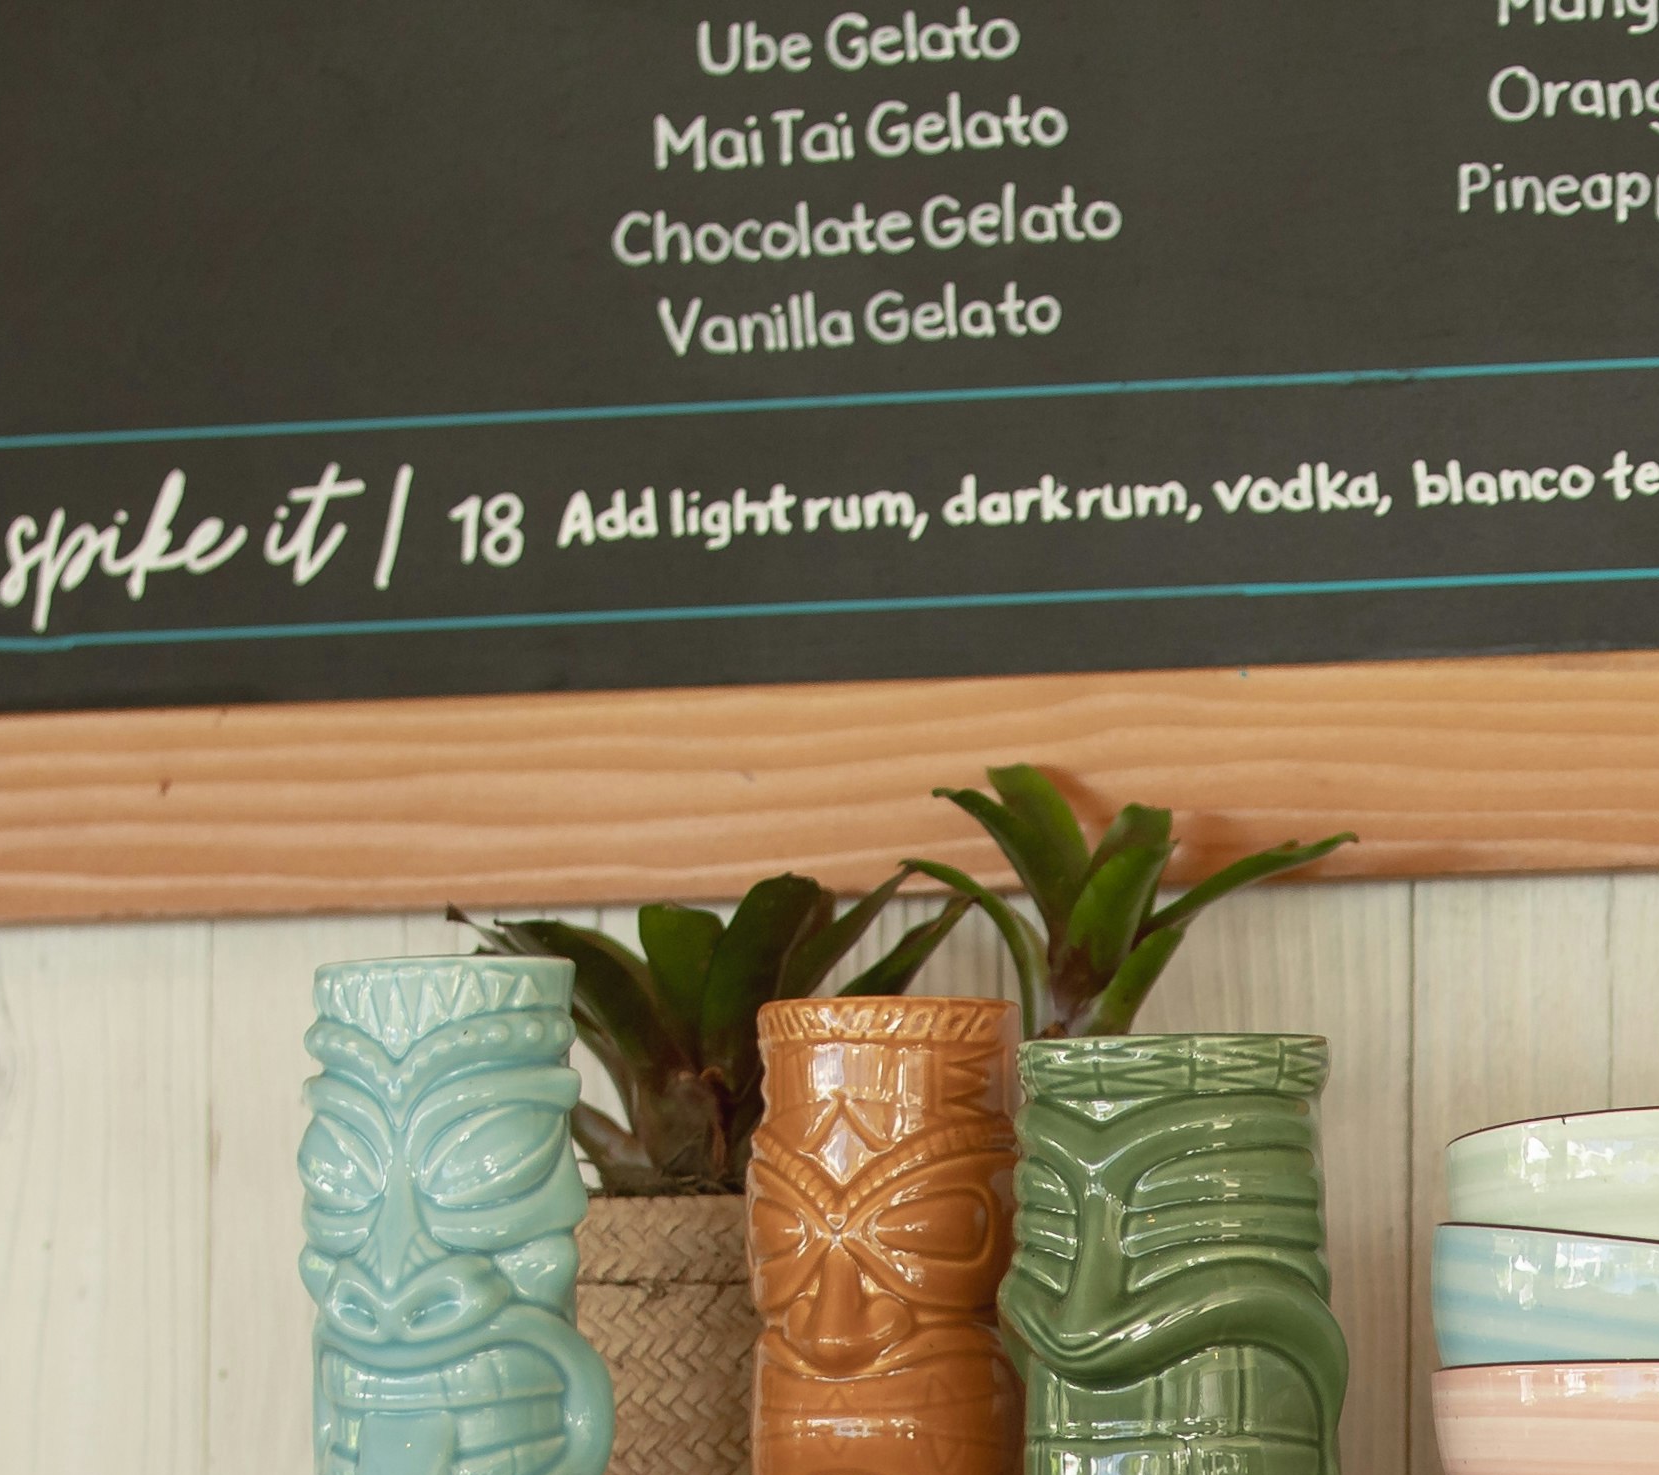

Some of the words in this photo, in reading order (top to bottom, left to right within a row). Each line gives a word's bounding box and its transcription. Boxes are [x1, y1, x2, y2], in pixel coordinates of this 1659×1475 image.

[696, 19, 814, 77] Ube
[824, 4, 1022, 72] Gelato
[652, 112, 770, 173] Mai
[770, 107, 856, 168] Tai
[864, 90, 1070, 159] Gelato
[611, 199, 917, 267] Chocolate
[920, 180, 1124, 251] Gelato
[656, 288, 856, 357] Vanilla
[863, 280, 1063, 345] Gelato
[261, 459, 368, 588] it
[446, 489, 527, 568] 18
[555, 483, 671, 552] Add
[668, 480, 799, 552] light
[801, 488, 931, 543] rum,
[940, 472, 1078, 528] dark
[1074, 472, 1205, 534] rum,
[1210, 459, 1394, 518] vodka,
[1410, 456, 1598, 510] blanco
